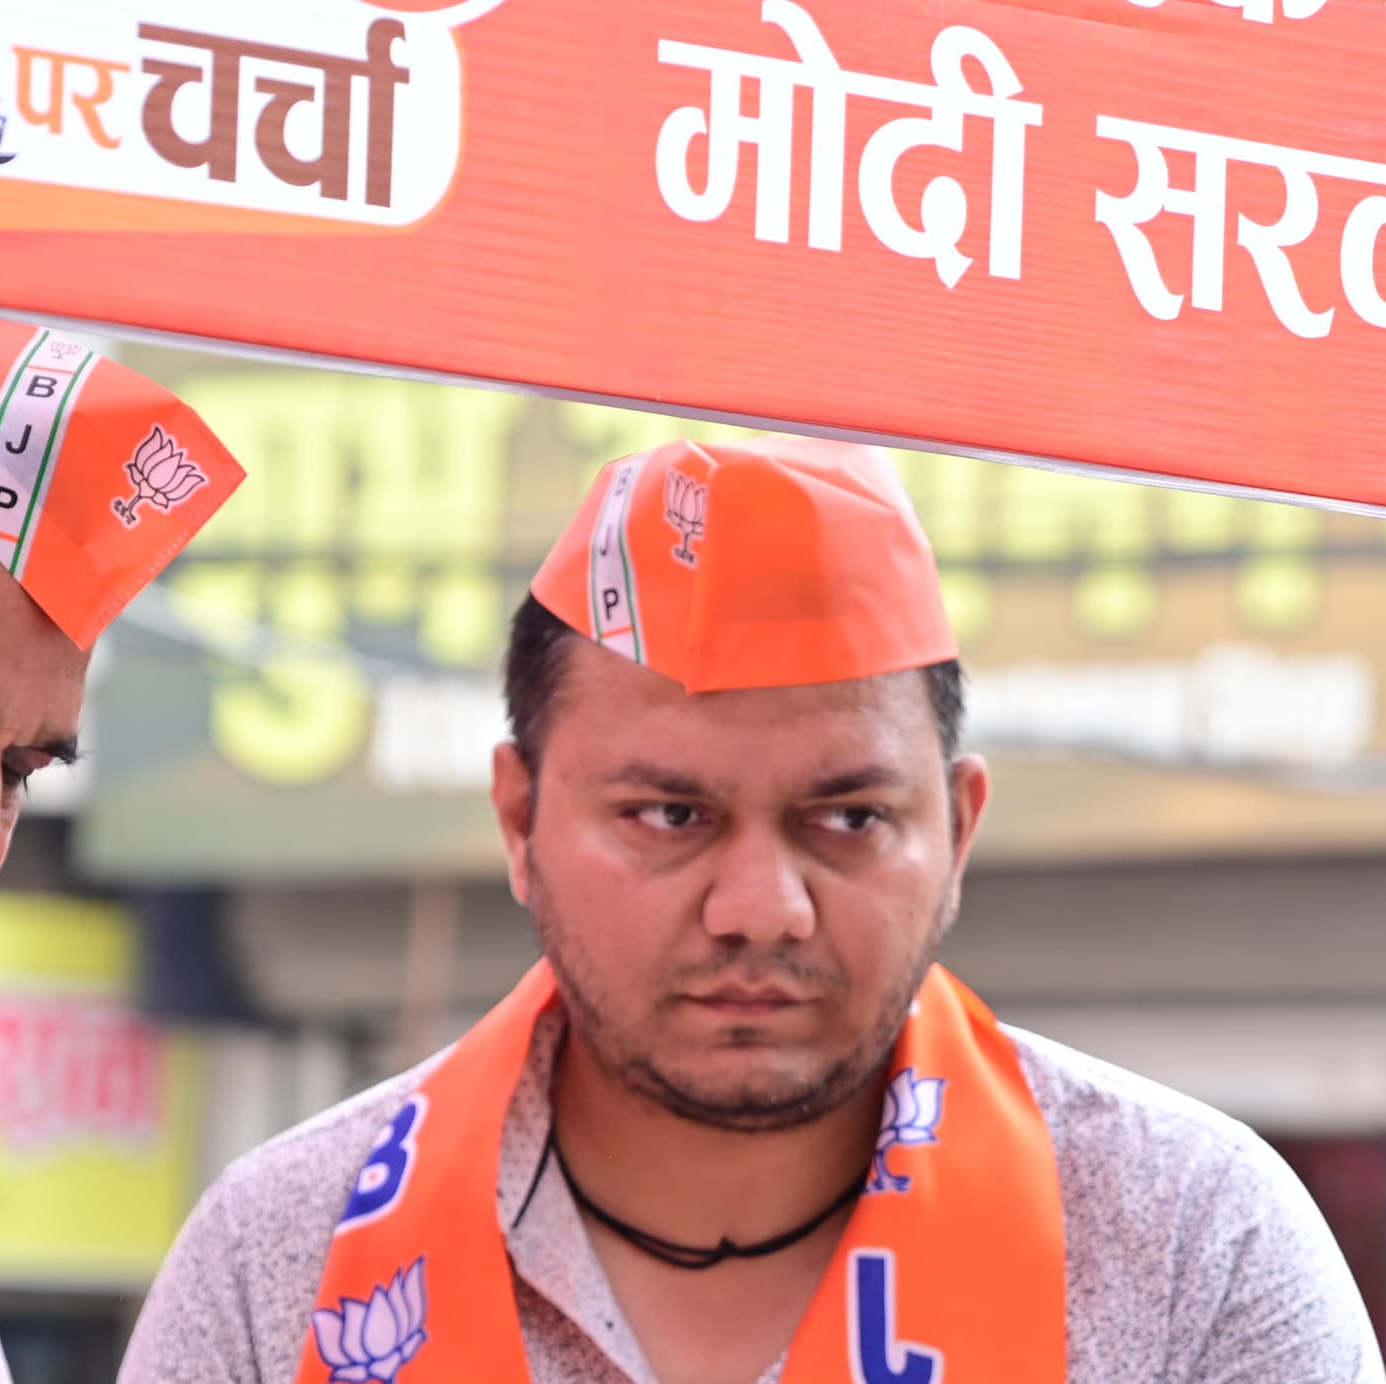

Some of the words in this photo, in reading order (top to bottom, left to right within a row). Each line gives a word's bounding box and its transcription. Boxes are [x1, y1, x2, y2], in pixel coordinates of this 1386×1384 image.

[13, 45, 132, 150] पर
[134, 17, 410, 209] चर्चा
[655, 0, 1043, 289] मोदी
